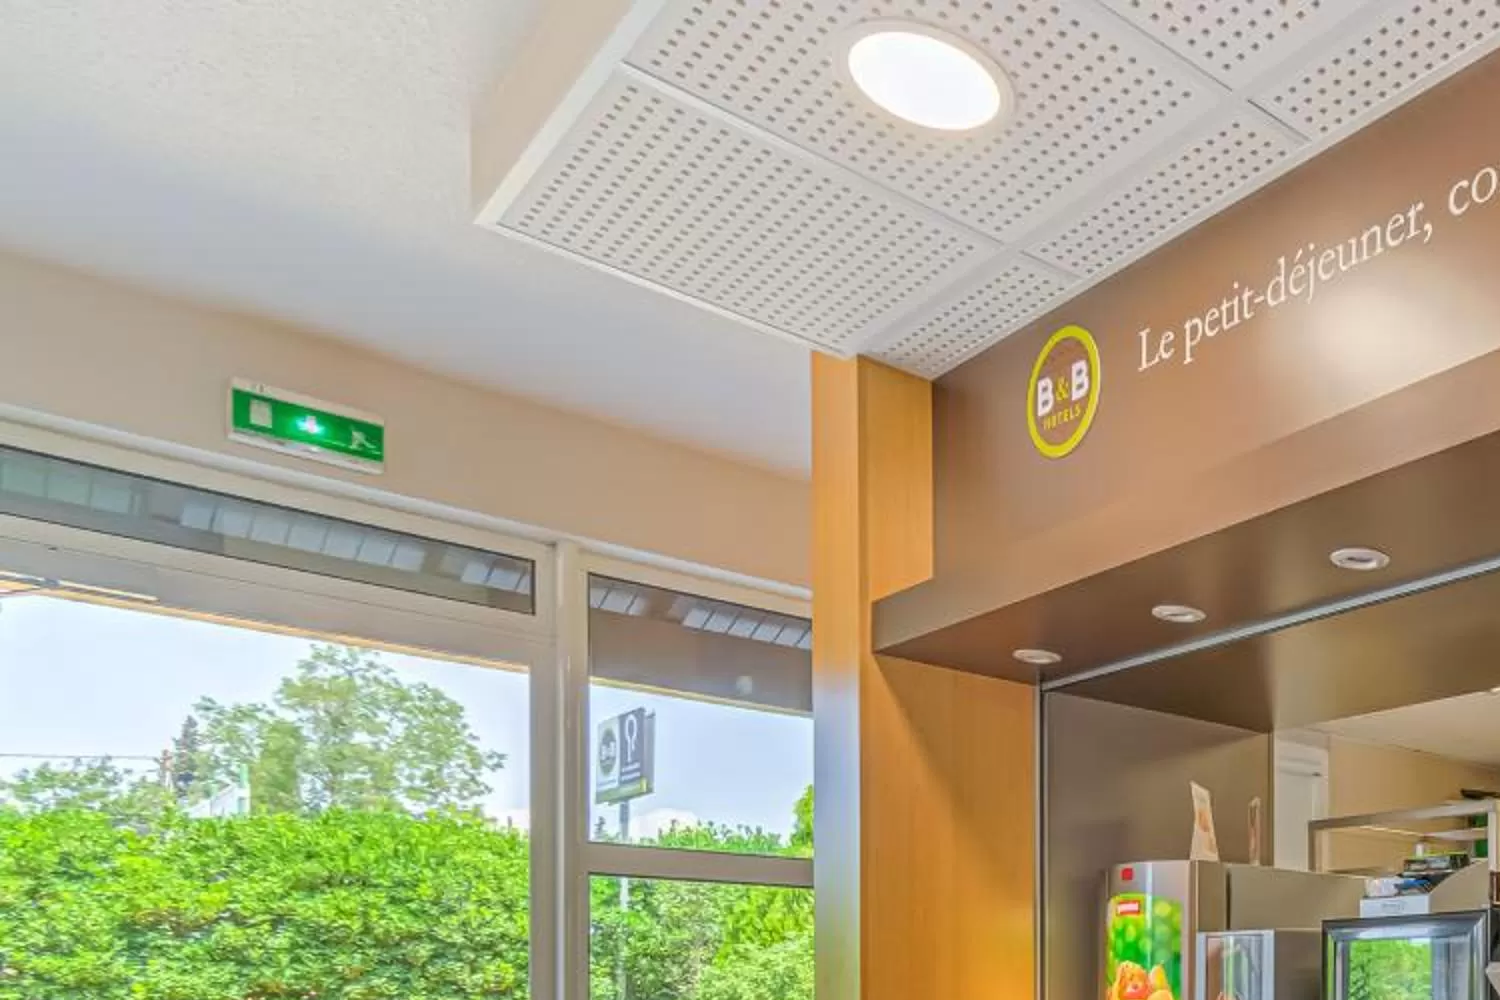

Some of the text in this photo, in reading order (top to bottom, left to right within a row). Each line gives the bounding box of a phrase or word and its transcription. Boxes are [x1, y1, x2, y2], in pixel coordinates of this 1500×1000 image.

[1137, 328, 1175, 372] Le
[1183, 200, 1434, 365] petit-déjeuner,
[1037, 359, 1090, 418] B&B
